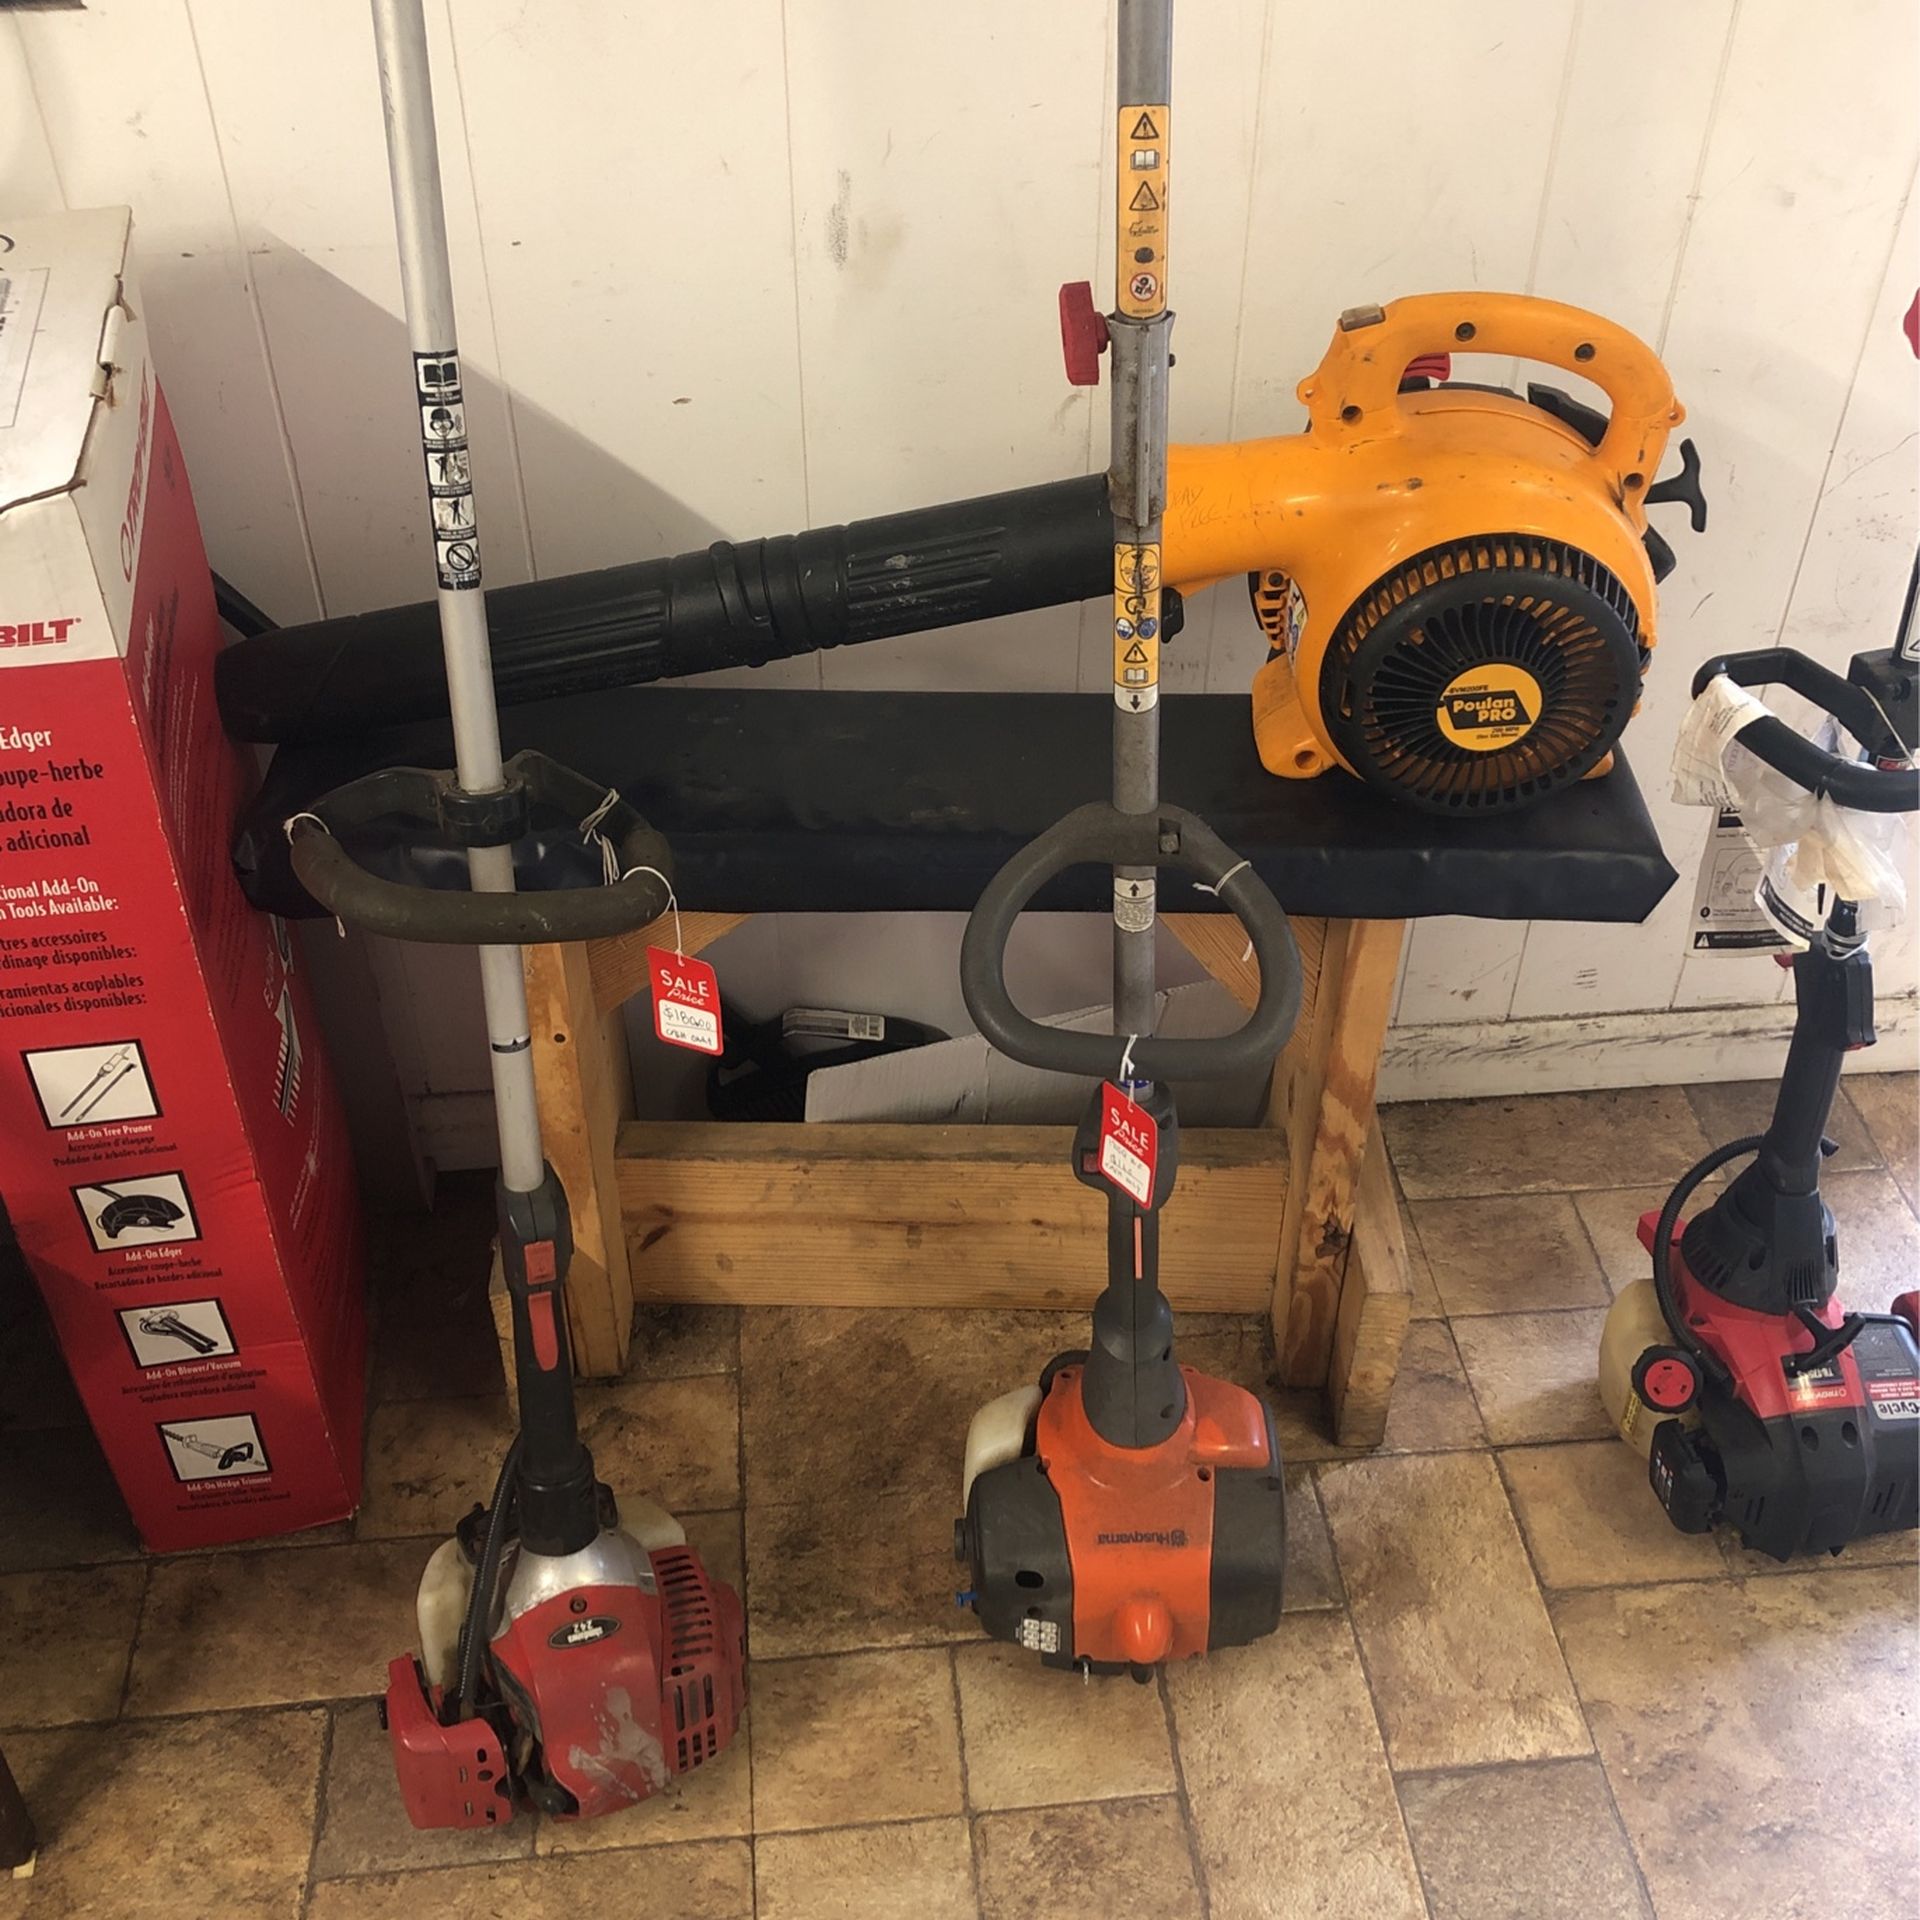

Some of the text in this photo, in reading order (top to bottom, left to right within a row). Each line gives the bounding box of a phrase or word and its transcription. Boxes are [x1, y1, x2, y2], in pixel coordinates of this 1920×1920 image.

[1452, 697, 1515, 713] Poulan
[1478, 707, 1517, 723] PRO
[0, 726, 52, 753] Edger
[51, 797, 73, 818] de
[6, 825, 90, 852] adicional
[0, 876, 99, 900] ional Add-On
[6, 901, 47, 919] Tools
[48, 895, 119, 915] Available:
[31, 929, 108, 948] accessoires
[0, 944, 138, 970] dinage disponibles:
[71, 972, 145, 994] acoplables
[660, 969, 710, 998] SALE
[63, 993, 148, 1013] disponibles:
[667, 988, 705, 1006] Price
[67, 1124, 153, 1141] Add-On Tree Pruner
[1110, 1107, 1149, 1151] SALE
[1113, 1129, 1145, 1156] Price
[125, 1247, 183, 1261] Add-On Edger
[146, 1368, 178, 1380] Add-On
[1878, 1402, 1918, 1414] Cycle
[1097, 1530, 1170, 1545] Husqvarna
